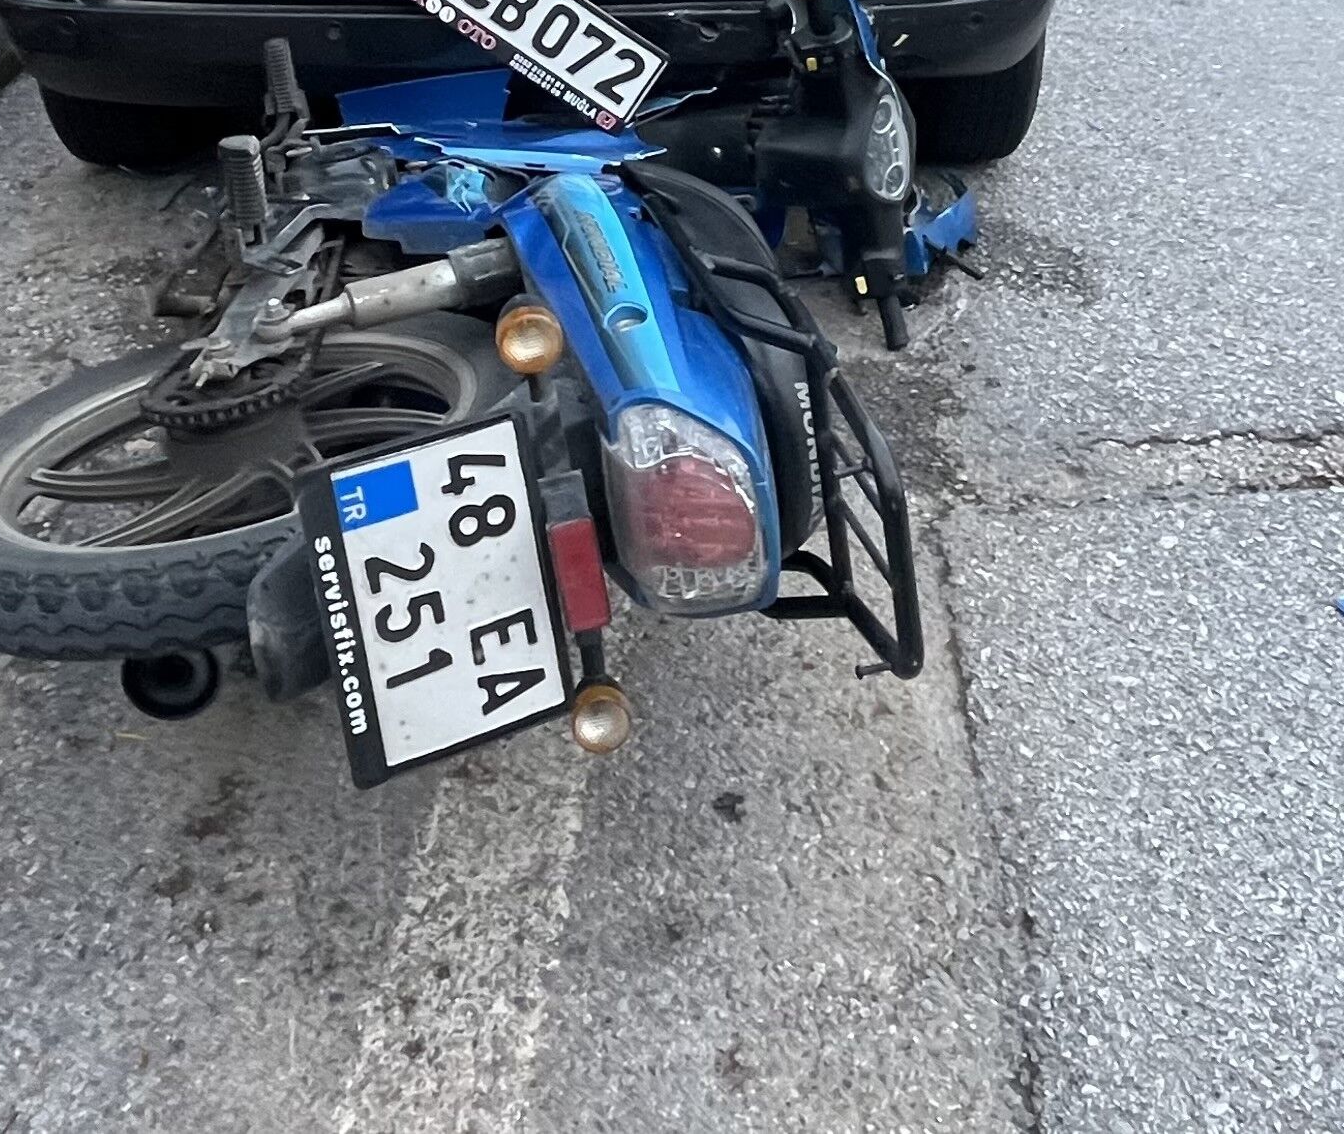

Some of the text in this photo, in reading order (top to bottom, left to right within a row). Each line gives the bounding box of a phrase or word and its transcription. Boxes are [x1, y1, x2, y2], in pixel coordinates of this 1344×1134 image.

[457, 19, 497, 50] OTO
[531, 2, 646, 105] 072
[562, 90, 597, 120] MUĞLA
[339, 485, 369, 523] TR
[314, 535, 369, 735] servisfix.com
[364, 542, 454, 690] 251
[440, 453, 546, 716] 48 EA
